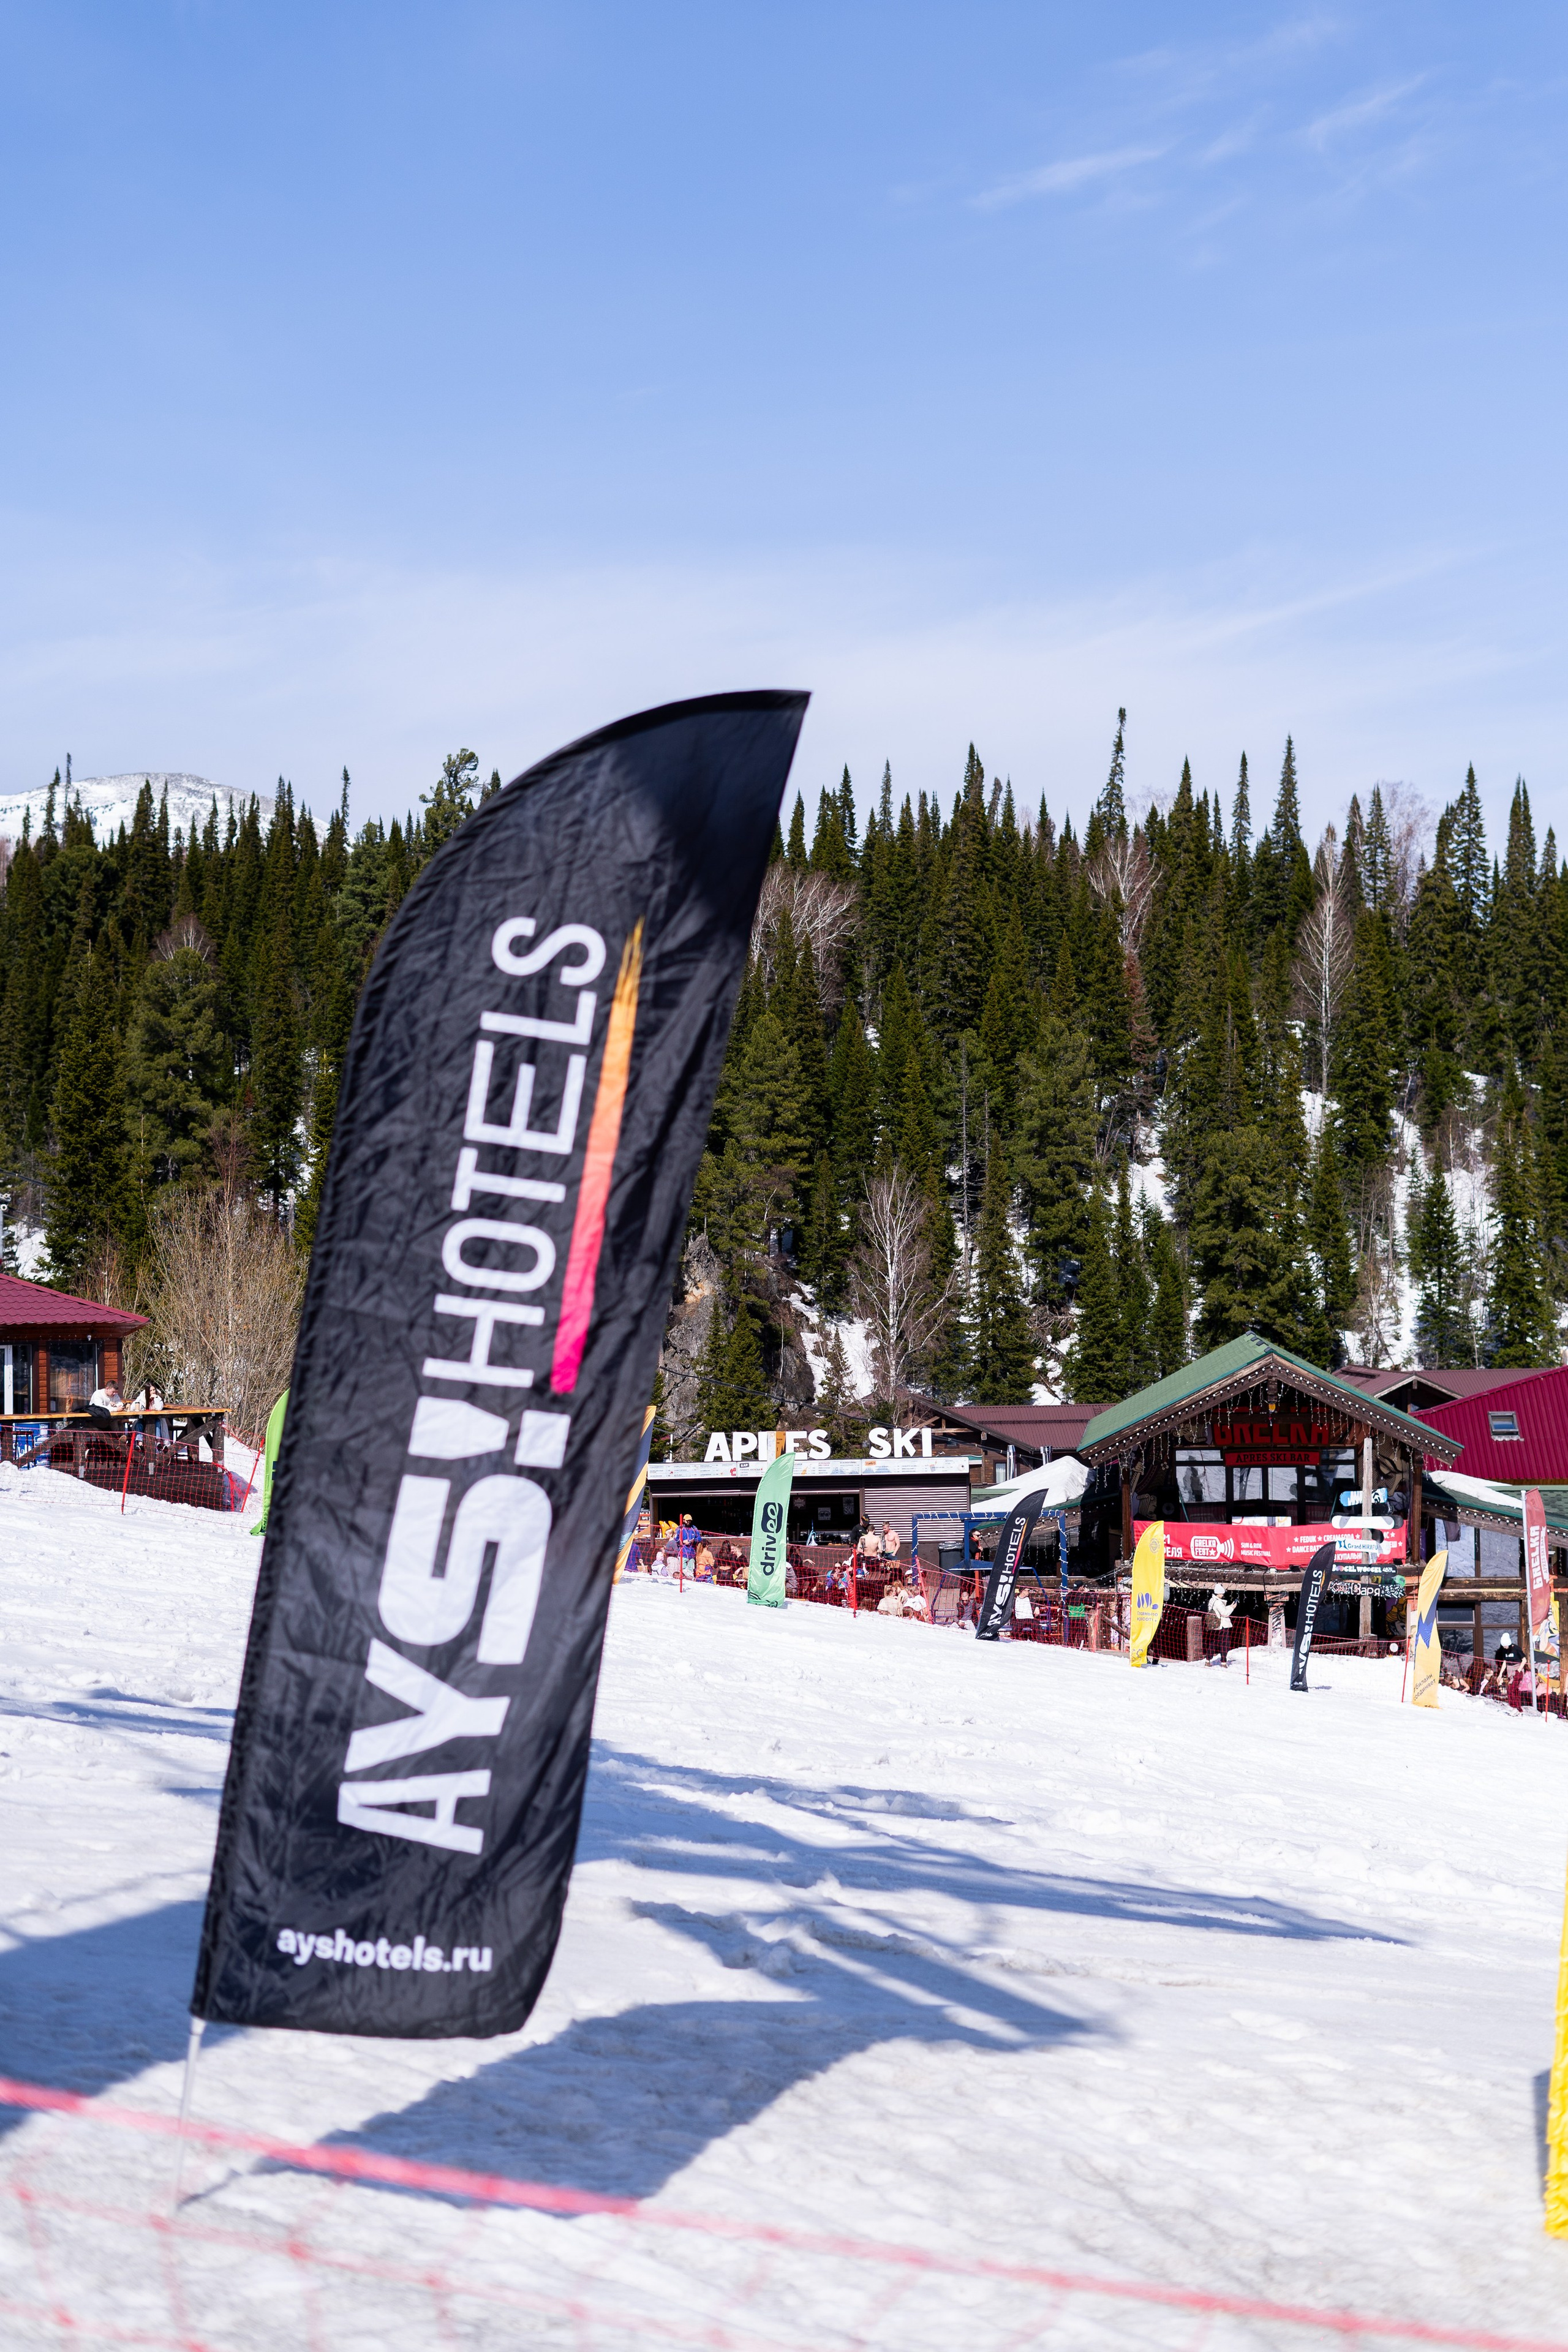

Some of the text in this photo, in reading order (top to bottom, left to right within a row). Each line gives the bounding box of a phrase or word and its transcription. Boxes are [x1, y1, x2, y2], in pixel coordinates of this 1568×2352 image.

[868, 1427, 932, 1458] SKI
[1235, 1453, 1310, 1463] APRES SKI BAR
[1194, 1539, 1216, 1548] GRELKA
[1337, 1552, 1362, 1561] КУПАЛЬН
[1529, 1525, 1544, 1590] GRELKA
[276, 1928, 493, 1972] ayshotels.ru
